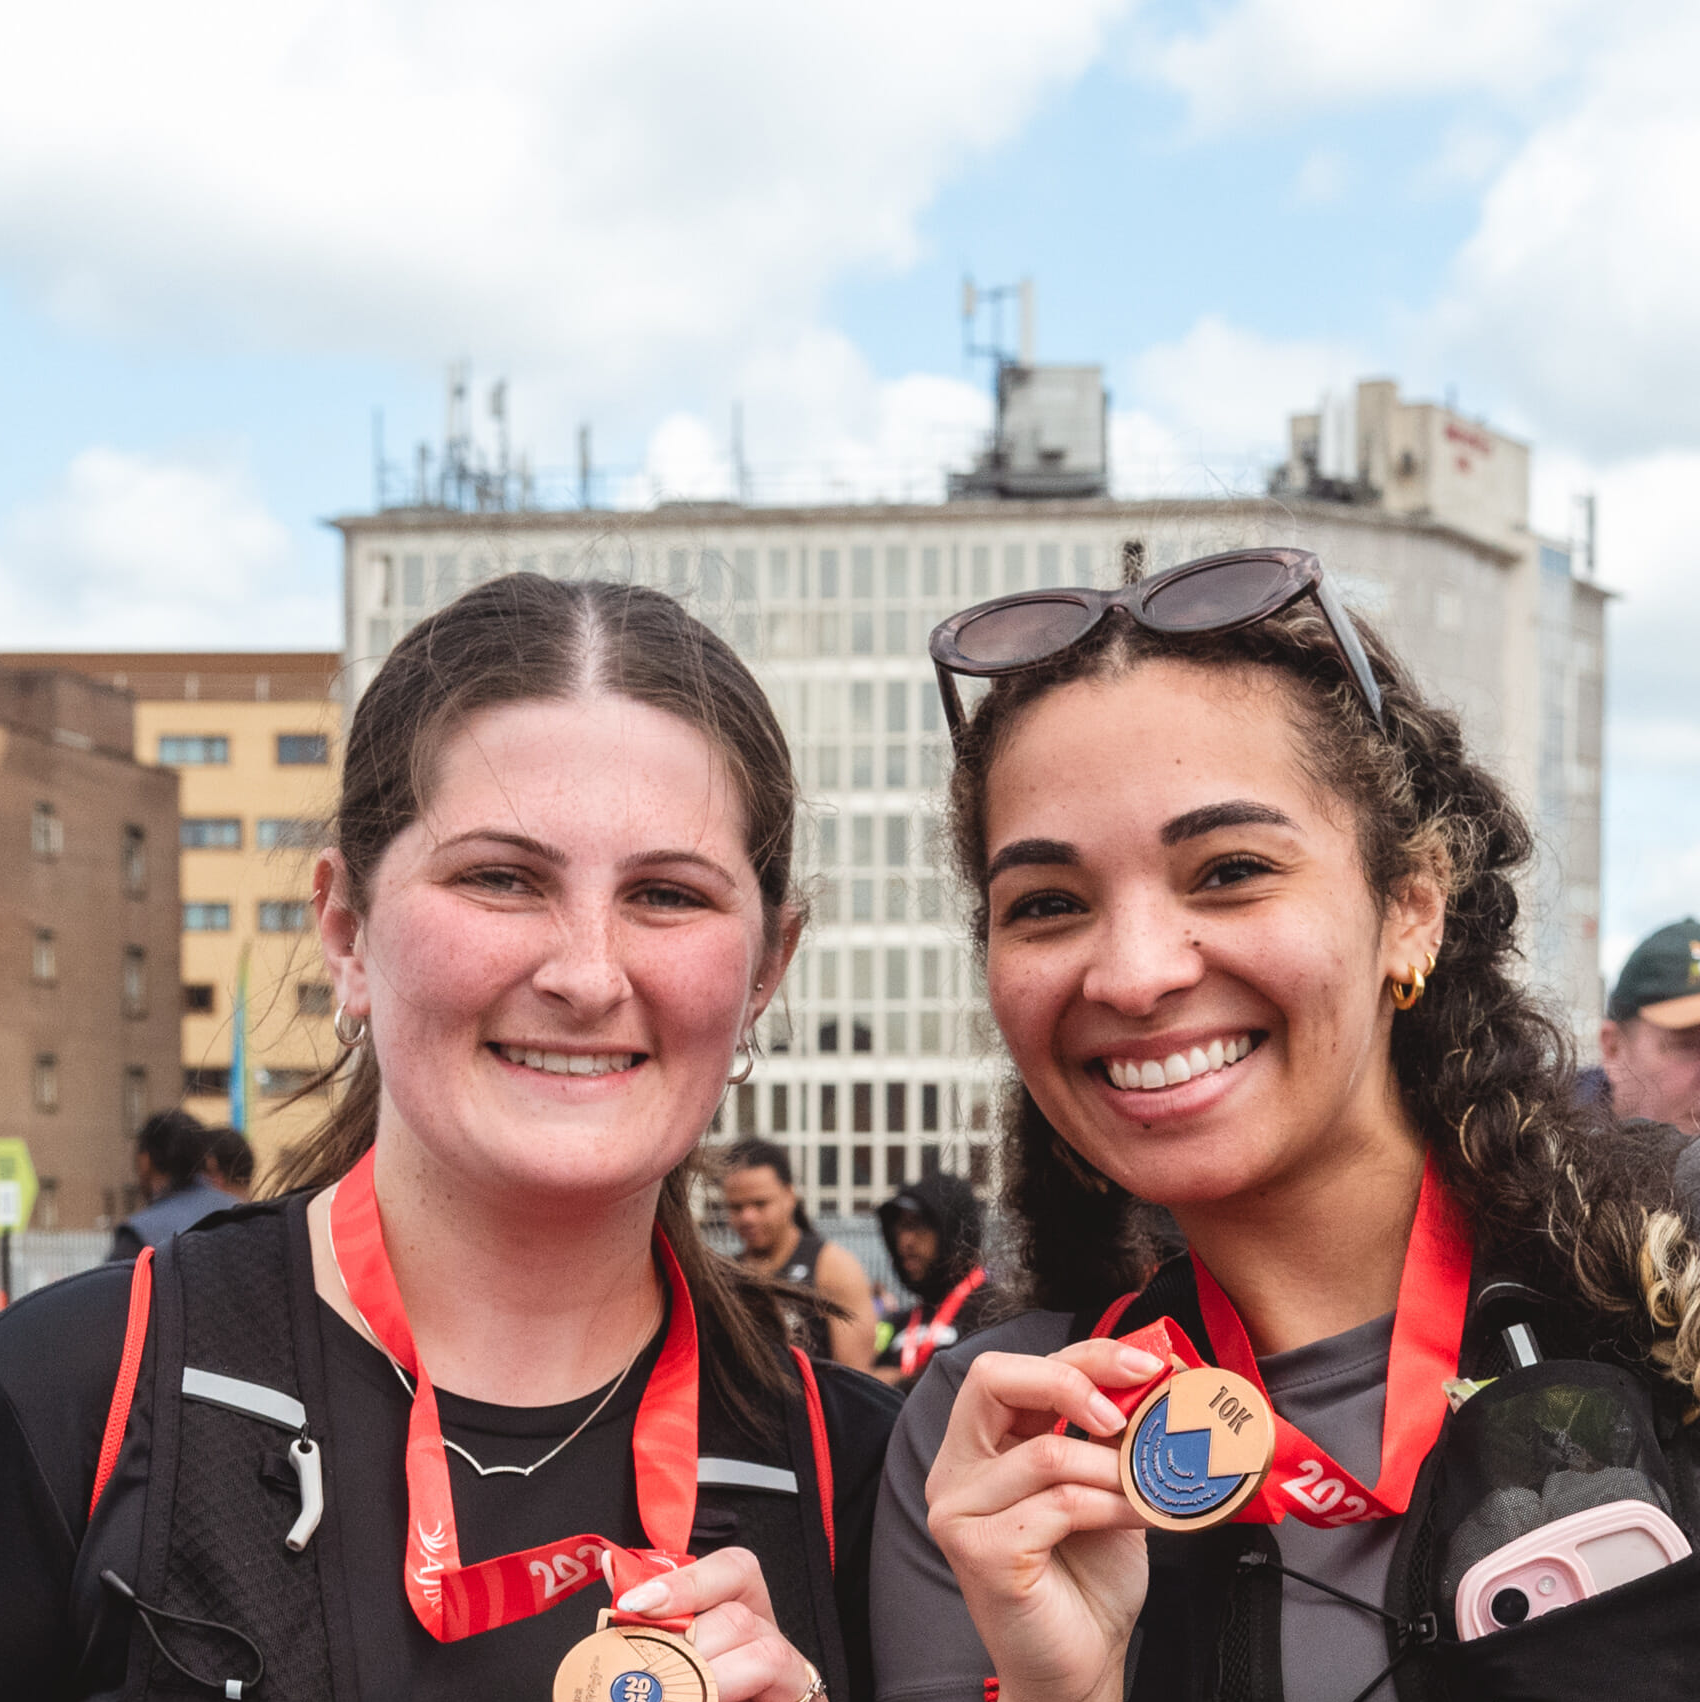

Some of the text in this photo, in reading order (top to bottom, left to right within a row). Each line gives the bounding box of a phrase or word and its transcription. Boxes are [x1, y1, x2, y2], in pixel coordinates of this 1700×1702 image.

[1208, 1385, 1254, 1436] 10K
[529, 1544, 604, 1599] 202
[625, 1675, 651, 1694] 20
